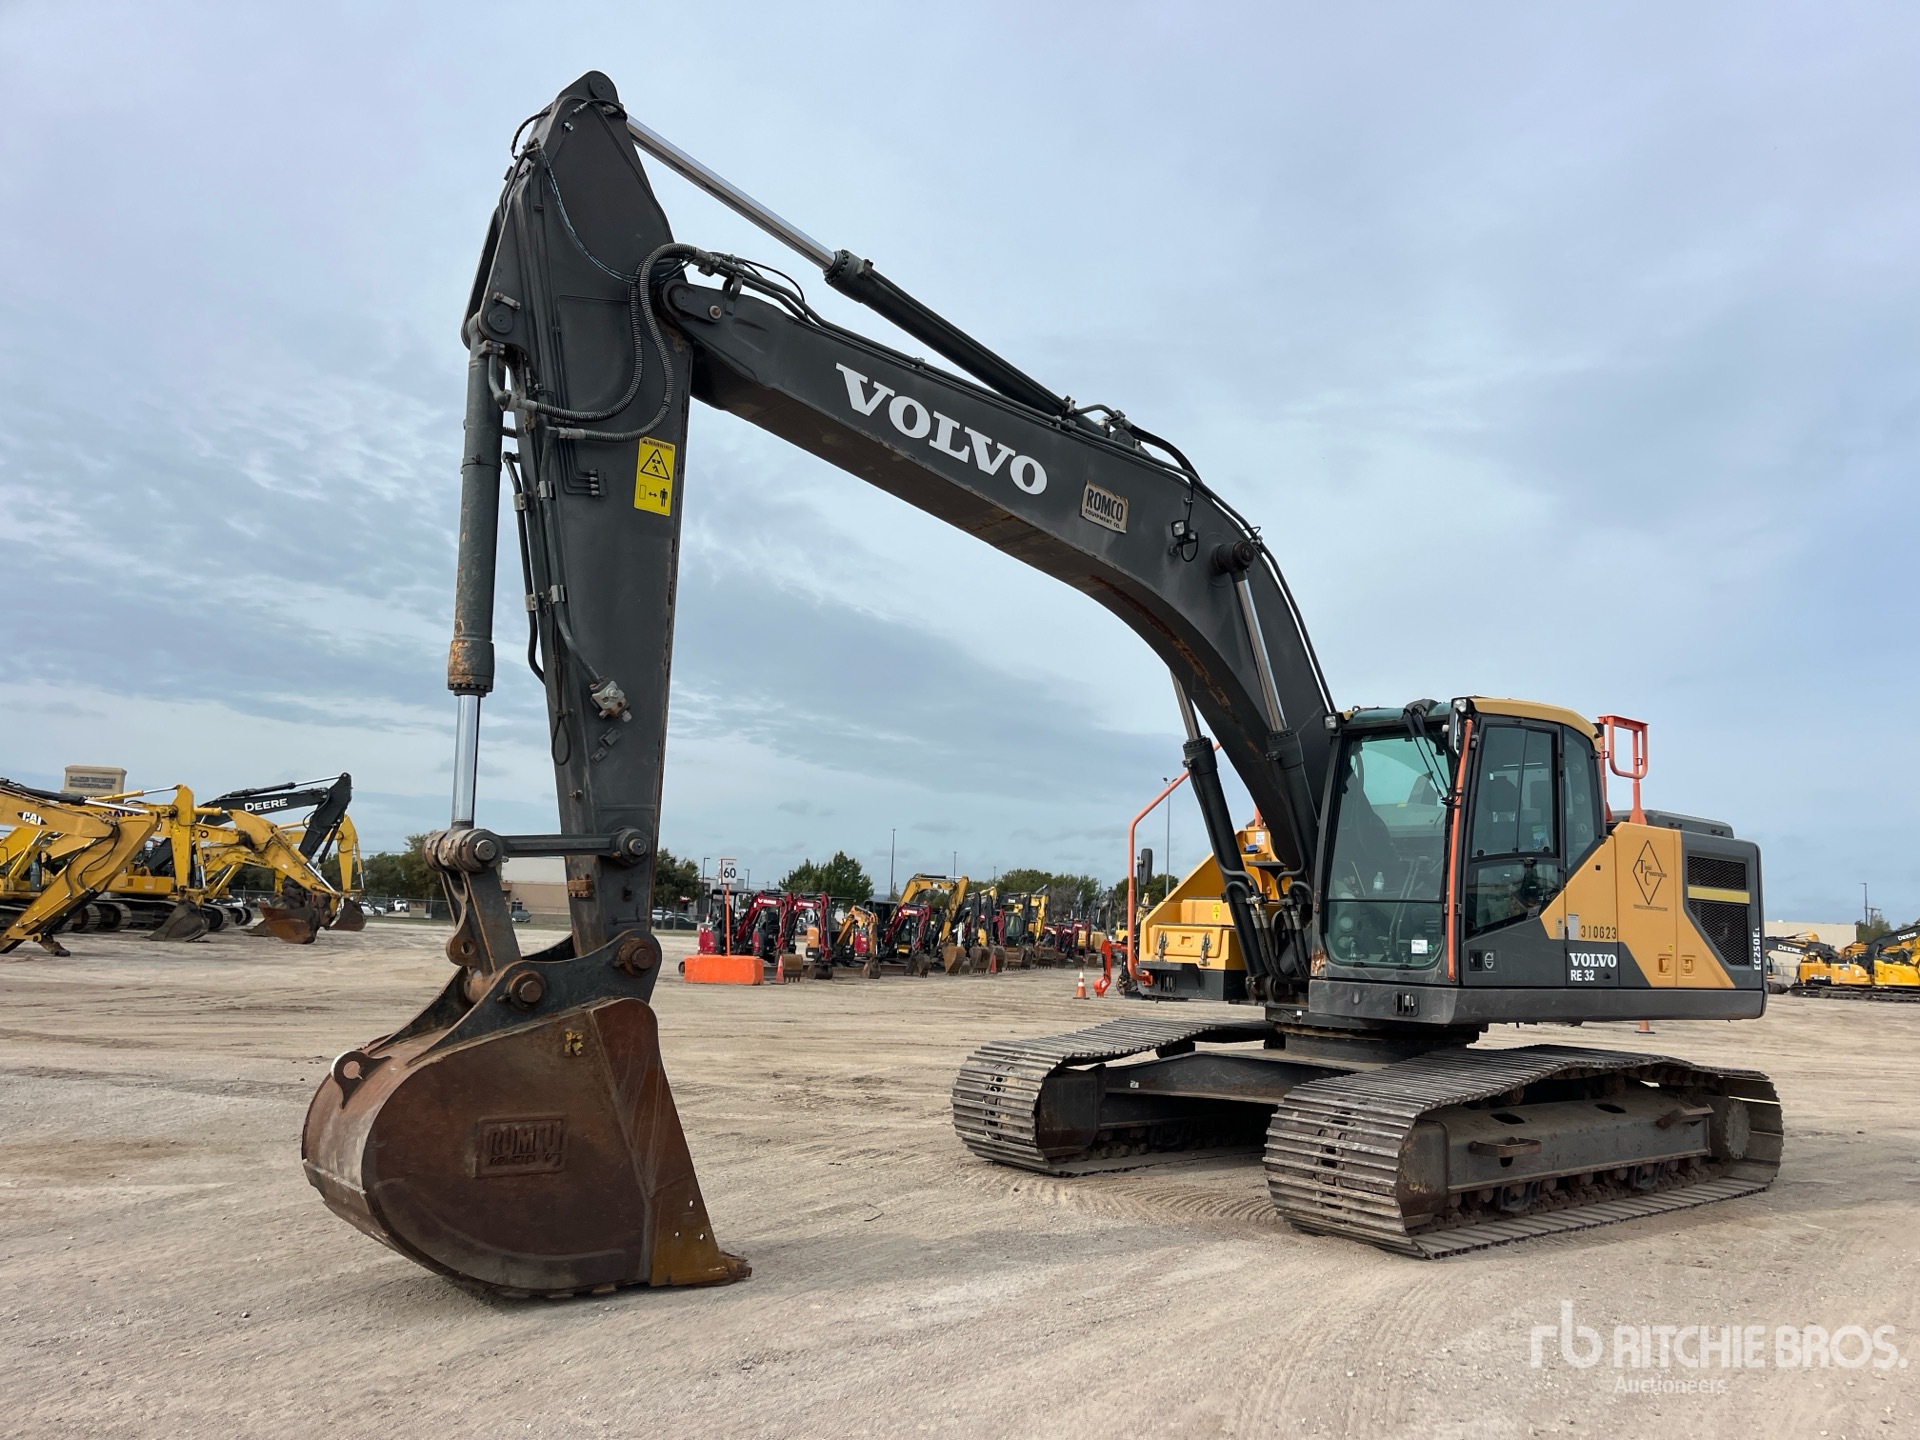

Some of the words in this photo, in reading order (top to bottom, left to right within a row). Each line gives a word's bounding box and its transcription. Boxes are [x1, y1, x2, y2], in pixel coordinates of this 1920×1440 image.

[836, 362, 1048, 495] VOLVO
[647, 440, 673, 450] WARNING
[1086, 488, 1124, 522] ROMCO
[1085, 508, 1112, 525] EQUIPMENT
[244, 798, 288, 812] DEERE
[723, 867, 736, 878] 60
[1897, 932, 1917, 941] DEERE
[1777, 944, 1801, 954] DEERE
[1569, 953, 1617, 968] VOLVO
[1570, 969, 1582, 981] RE
[1584, 969, 1595, 981] 32
